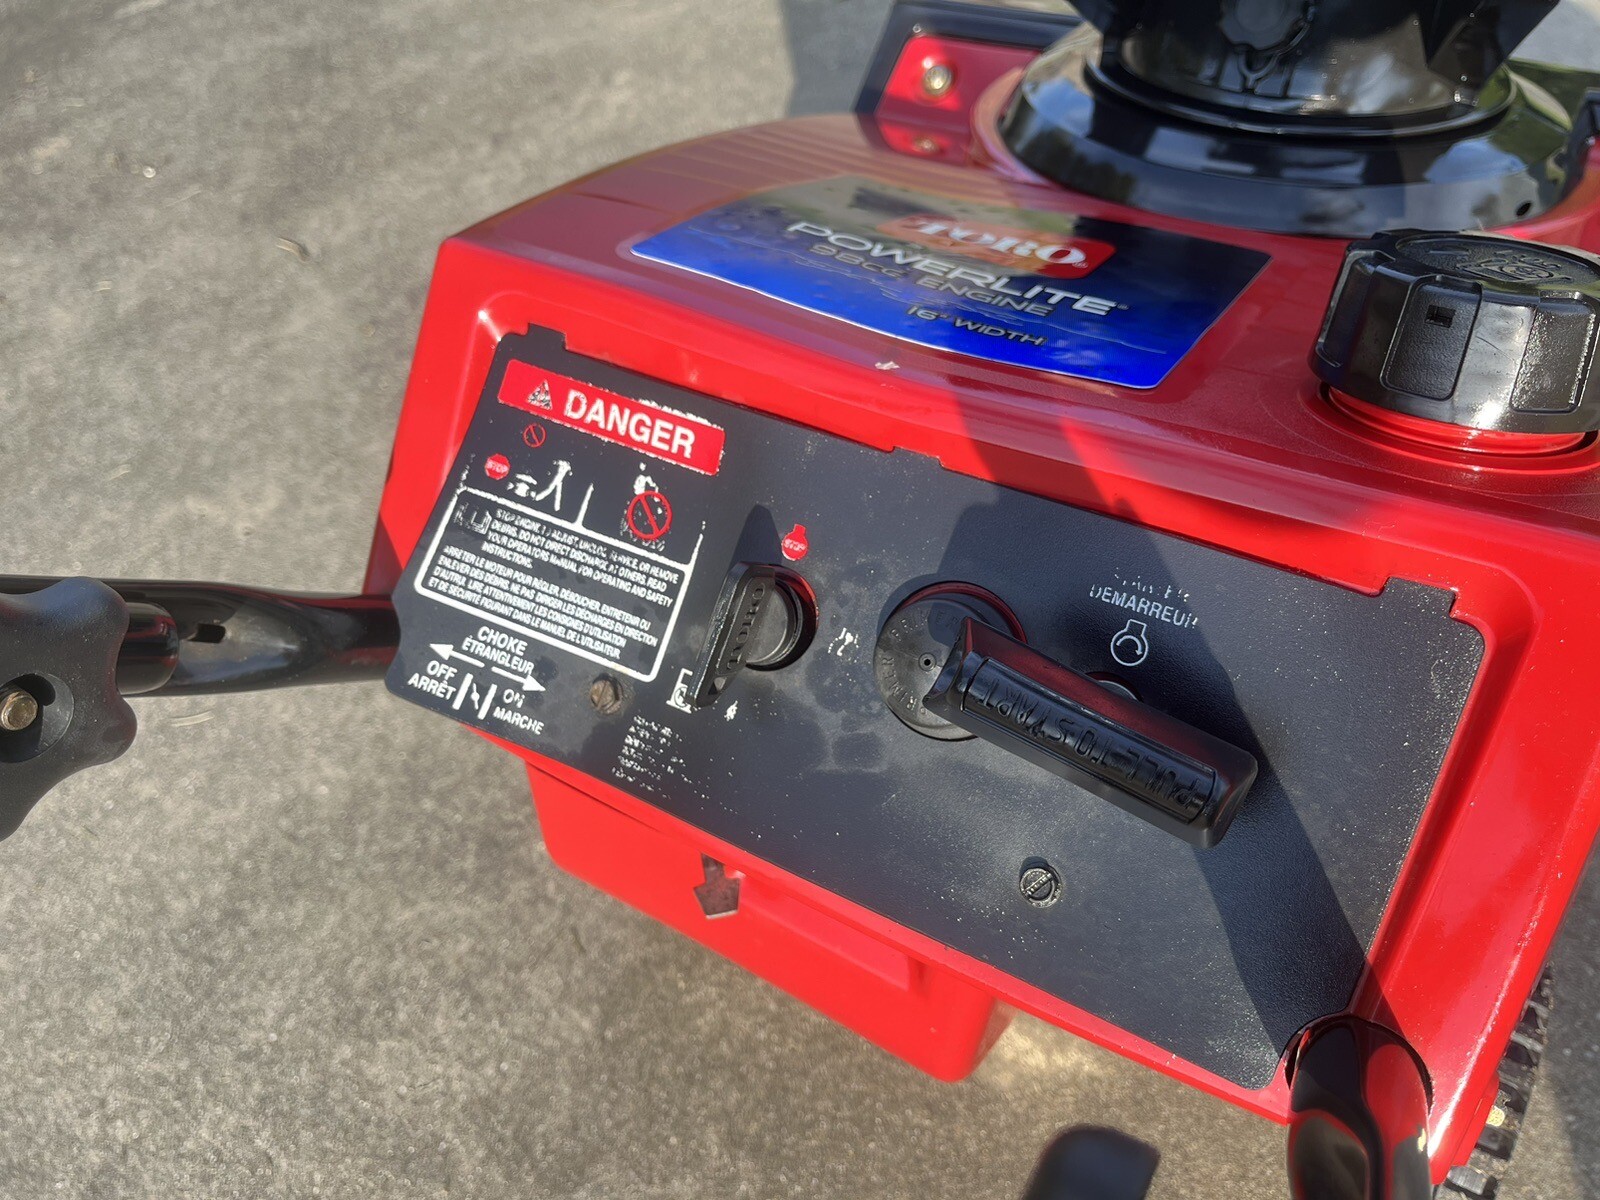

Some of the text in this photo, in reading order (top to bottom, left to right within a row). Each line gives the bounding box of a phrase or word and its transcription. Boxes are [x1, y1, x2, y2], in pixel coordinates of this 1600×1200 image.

[911, 220, 1087, 265] TORO
[785, 222, 1118, 316] POWERLITE
[916, 276, 1055, 317] ENGINE
[954, 317, 1047, 347] WIDTH
[563, 389, 696, 459] DANGER
[480, 541, 535, 569] INSTRUCTIONS.
[486, 529, 508, 546] YOUR
[591, 569, 633, 592] OPERATING
[630, 583, 648, 598] AND
[645, 588, 674, 607] SAFETY
[517, 529, 530, 542] DO
[529, 533, 546, 547] NOT
[543, 539, 570, 556] DIRECT
[645, 576, 667, 592] READ
[638, 561, 651, 573] OR
[649, 565, 679, 583] REMOVE
[427, 576, 439, 589] ET
[437, 580, 450, 593] DE
[479, 596, 514, 617] FIGURANT
[511, 608, 532, 623] DANS
[529, 615, 541, 627] LE
[539, 618, 567, 637] MANUEL
[565, 628, 578, 641] DE
[437, 555, 471, 575] ENLEVER
[469, 567, 485, 580] DES
[508, 581, 521, 594] NE
[519, 585, 535, 599] PAS
[561, 601, 576, 615] LES
[623, 625, 657, 645] DIRECTION
[467, 578, 484, 593] LIRE
[482, 584, 535, 612] ATTENTIVEMENT
[533, 603, 548, 617] LES
[546, 608, 585, 631] CONSIGNES
[474, 556, 485, 568] LE
[483, 560, 514, 579] MOTEUR
[511, 570, 533, 586] POUR
[638, 618, 651, 631] OU
[461, 635, 535, 675] ÉTRANGLEUR
[477, 625, 528, 656] CHOKE
[407, 672, 457, 700] ARRÊT
[426, 660, 458, 680] OFF
[502, 689, 526, 708] ON
[492, 706, 545, 736] MARCHE
